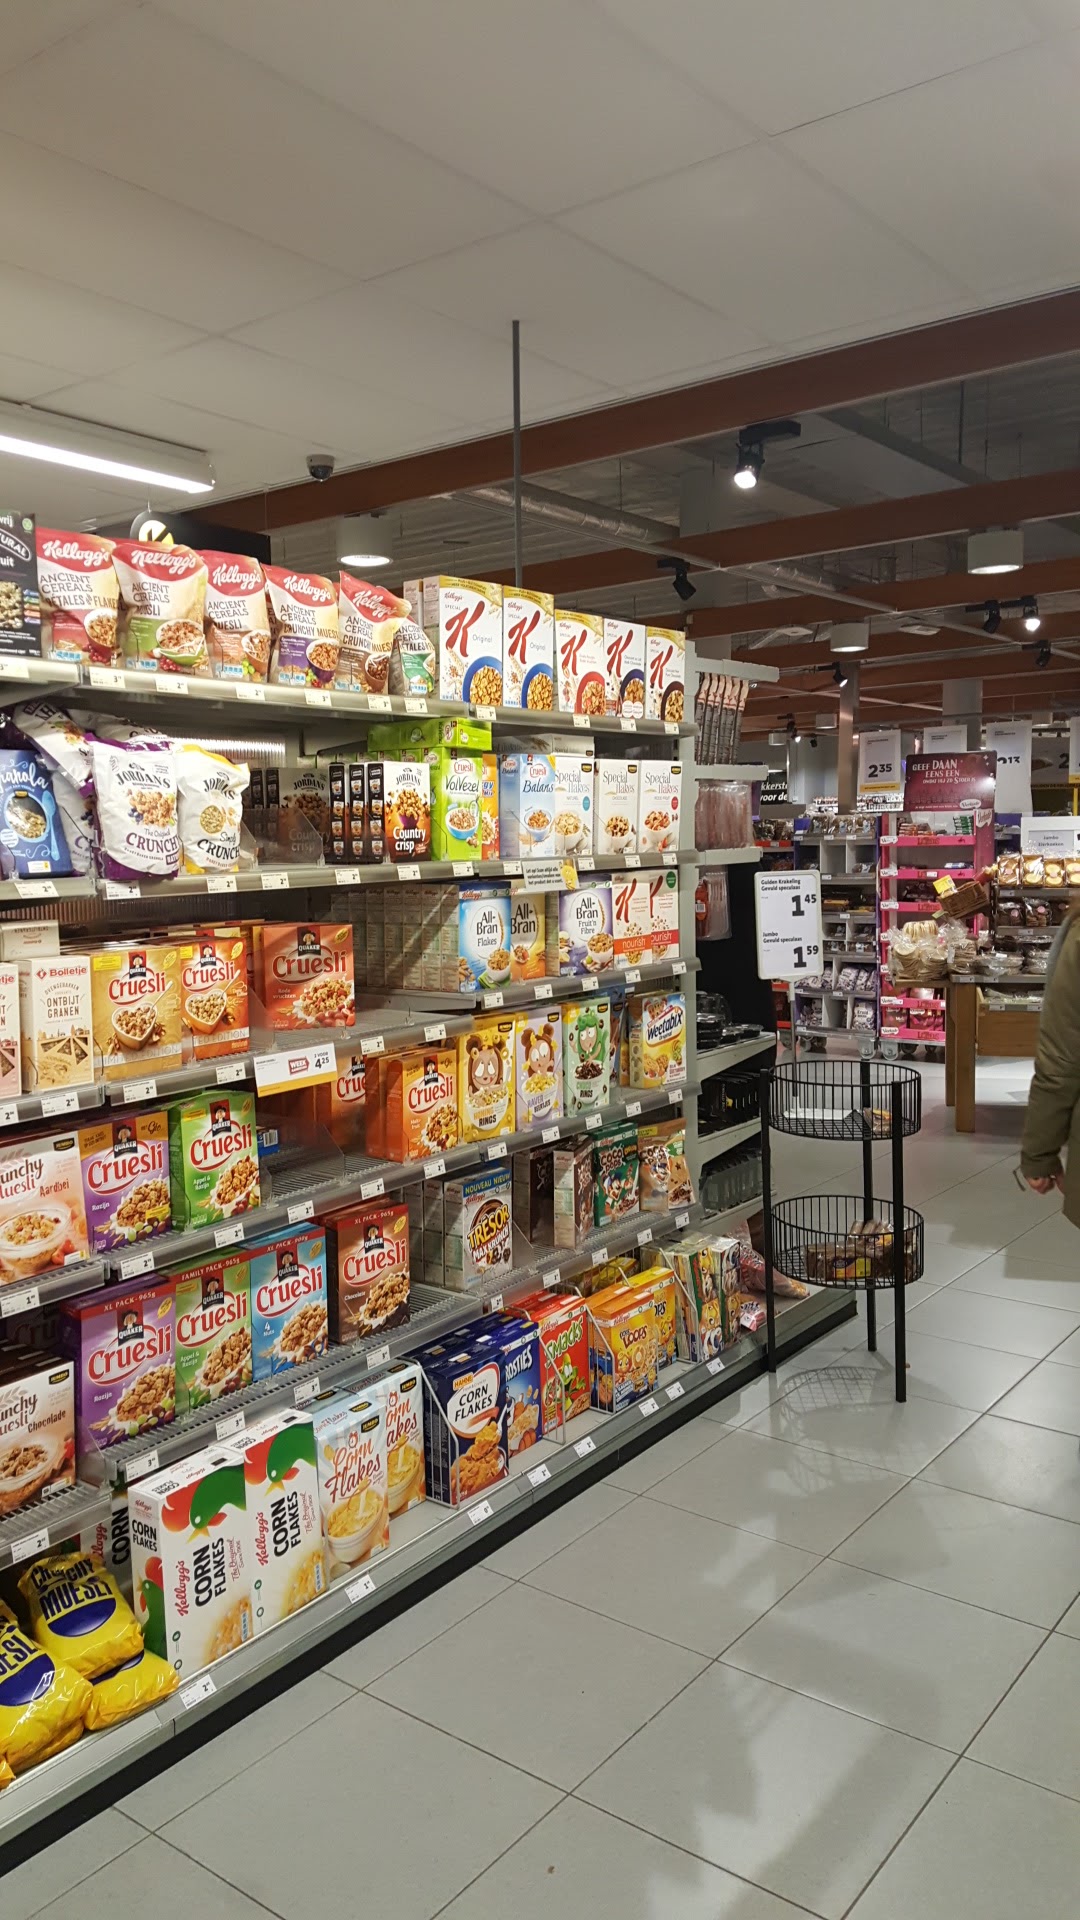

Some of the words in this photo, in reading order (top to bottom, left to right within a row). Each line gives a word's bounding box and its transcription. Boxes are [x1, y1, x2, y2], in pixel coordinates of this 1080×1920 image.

[43, 540, 110, 567] Kellogg's
[131, 549, 196, 575] Kellogg's
[40, 572, 90, 584] ANCIENT
[212, 563, 262, 590] Kellogg's
[41, 584, 93, 594] CEREALS
[131, 582, 170, 594] ANCIENT
[283, 575, 332, 602] Kellogg's
[133, 592, 170, 604] CEREALS
[444, 591, 463, 602] Kellogg's
[207, 600, 246, 611] ANCIENT
[280, 604, 316, 618] ANCIENT
[352, 590, 397, 619] Kellogg's
[208, 608, 249, 620] CEREALS
[280, 612, 317, 626] CEREALS
[283, 623, 315, 637] CRUNCHY
[344, 625, 373, 641] CEREALS
[445, 600, 486, 657] K
[472, 634, 493, 644] Original
[508, 610, 541, 665] K
[529, 642, 546, 651] Original
[560, 629, 588, 676] K
[606, 629, 634, 678] K
[650, 645, 674, 689] K
[453, 760, 475, 774] Cruesli
[529, 766, 547, 777] Cruesli
[912, 763, 930, 771] GEEF
[932, 759, 958, 770] DAAN
[0, 762, 49, 789] ranola
[117, 771, 171, 789] JORDANS
[396, 774, 421, 786] JORDANS
[555, 770, 581, 784] Special
[603, 771, 628, 785] Special
[645, 773, 671, 786] Special
[925, 770, 943, 778] EENS
[446, 775, 480, 793] VolVezel
[522, 780, 554, 793] Balans
[568, 782, 590, 793] flakes
[615, 782, 635, 794] flakes
[658, 783, 679, 794] flakes
[393, 826, 426, 841] Country
[395, 839, 415, 854] crisp
[581, 898, 596, 911] All-
[615, 878, 637, 923] K
[481, 911, 496, 924] All-
[576, 908, 599, 919] Bran
[476, 922, 498, 936] Bran
[511, 918, 536, 934] Bran
[581, 925, 595, 935] Fibre
[477, 937, 497, 948] Flakes
[622, 937, 646, 948] nourish
[273, 951, 347, 976] Cruesli
[50, 967, 87, 977] Bolletje
[182, 962, 235, 987] Cruesli
[109, 972, 166, 999] Cruesli
[47, 995, 80, 1007] ONTBIJT
[47, 1006, 80, 1019] GRANEN
[647, 1011, 683, 1041] Weetabix
[290, 1059, 307, 1069] WEEK
[408, 1076, 454, 1111] Cruesli
[473, 1106, 495, 1119] HONING
[534, 1100, 551, 1115] BEERTJES
[212, 1120, 231, 1130] QUAKER
[478, 1114, 498, 1127] RINGS
[114, 1141, 137, 1152] QUAKER
[190, 1124, 252, 1166] Cruesli
[600, 1149, 623, 1166] COCO
[87, 1146, 163, 1189] Cruesli
[605, 1159, 621, 1173] POPS
[39, 1178, 70, 1198] Aardbei
[195, 1181, 210, 1191] Razijn
[465, 1179, 491, 1194] NOUVEAU
[493, 1173, 511, 1184] NIEUW
[91, 1202, 110, 1211] Razijn
[467, 1204, 510, 1250] TRÉSOR
[365, 1237, 384, 1249] QUAKER
[473, 1247, 487, 1261] MAX
[488, 1225, 509, 1251] KRUNCH
[343, 1238, 407, 1282] Cruesli
[181, 1267, 205, 1281] FAMILY
[278, 1265, 300, 1278] QUAKER
[256, 1264, 323, 1313] Cruesli
[202, 1291, 224, 1305] QUAKER
[104, 1303, 114, 1311] XL
[176, 1292, 247, 1343] Cruesli
[118, 1325, 144, 1340] QUAKER
[264, 1321, 270, 1332] 4
[545, 1316, 583, 1361] SMACKS
[623, 1325, 647, 1349] LOOPS
[88, 1324, 171, 1378] Cruesli
[505, 1345, 533, 1382] ROSTIES
[401, 1380, 416, 1391] JUMBO
[454, 1374, 473, 1388] HAHNE
[94, 1391, 113, 1402] Razijn
[459, 1384, 489, 1406] CORN
[386, 1397, 412, 1428] orn
[454, 1394, 493, 1423] FLAKES
[28, 1410, 66, 1433] Chocolade
[362, 1418, 379, 1430] JUMBO
[386, 1412, 418, 1448] akes
[333, 1438, 374, 1476] Corn
[325, 1453, 380, 1504] Flakes
[299, 1491, 311, 1524] Original
[270, 1498, 291, 1558] CORN
[286, 1491, 303, 1550] FLAKES
[305, 1521, 313, 1535] The
[112, 1506, 130, 1566] CORN
[131, 1519, 157, 1541] CORN
[132, 1533, 158, 1552] FLAKES
[253, 1511, 270, 1567] Kellogg's
[229, 1537, 238, 1567] Original
[213, 1537, 227, 1599] FLAKES
[232, 1567, 240, 1582] The
[193, 1544, 213, 1608] CORN
[174, 1560, 192, 1617] Kellogg's
[39, 1582, 113, 1621] MUESLI
